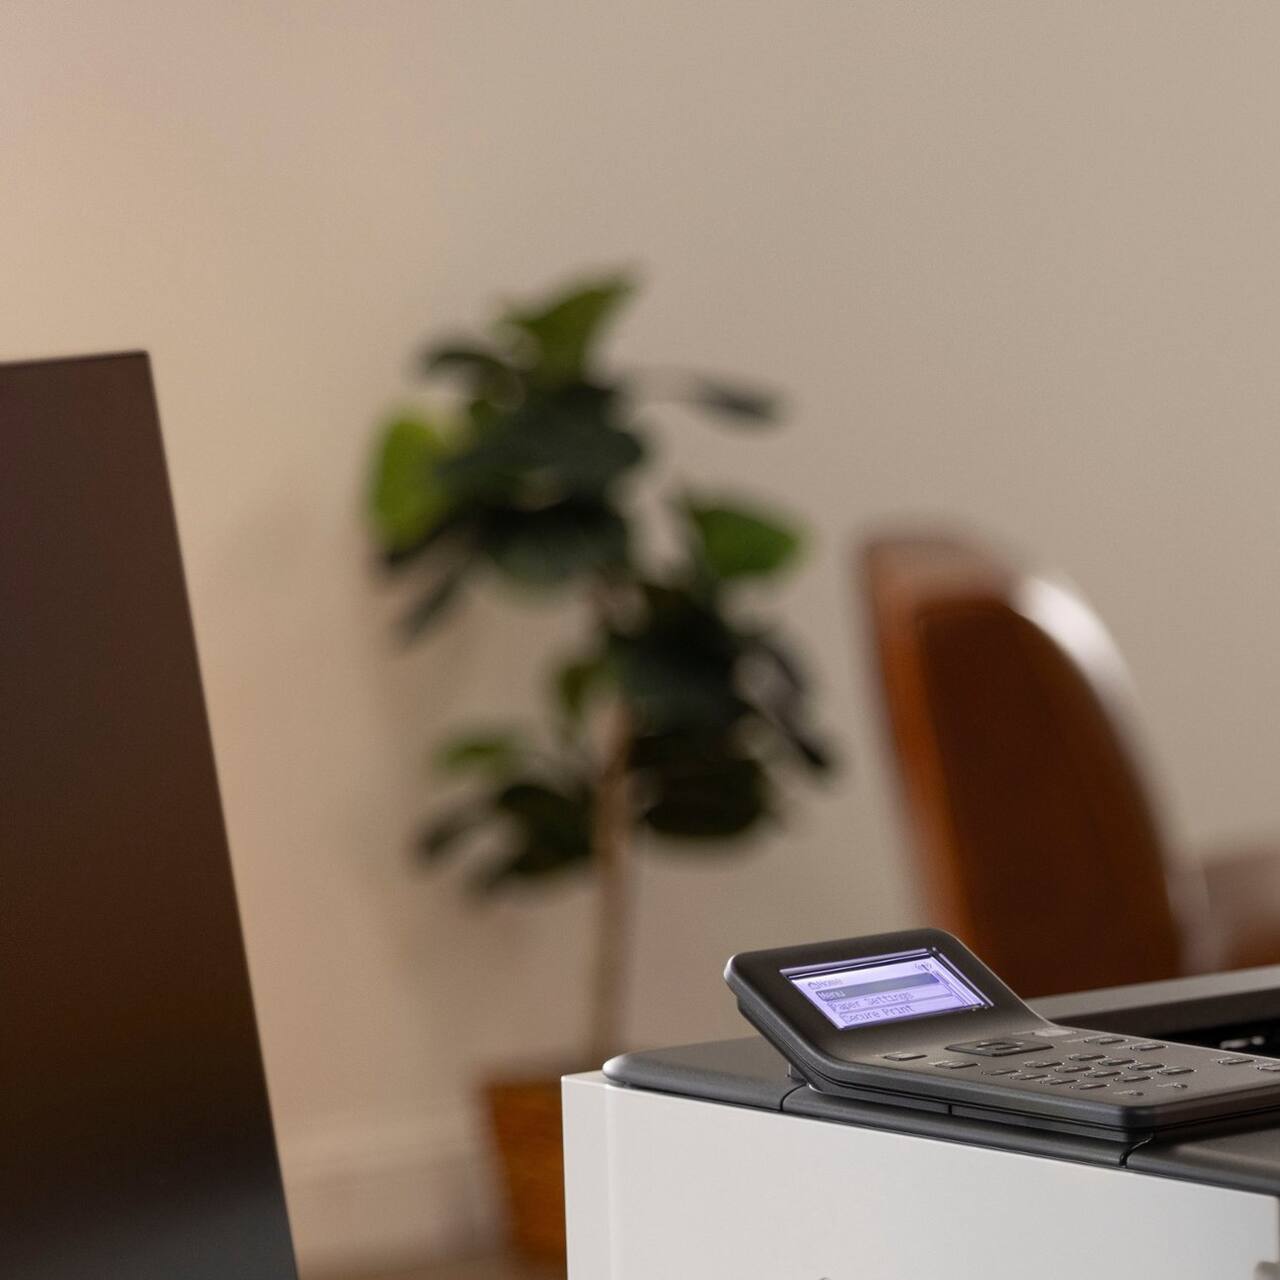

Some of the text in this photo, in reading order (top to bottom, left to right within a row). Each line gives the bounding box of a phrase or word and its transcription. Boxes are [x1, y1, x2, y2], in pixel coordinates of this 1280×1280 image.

[819, 988, 846, 1000] Menu
[826, 991, 916, 1013] Paper Settings
[840, 1004, 915, 1023] Secure Print
